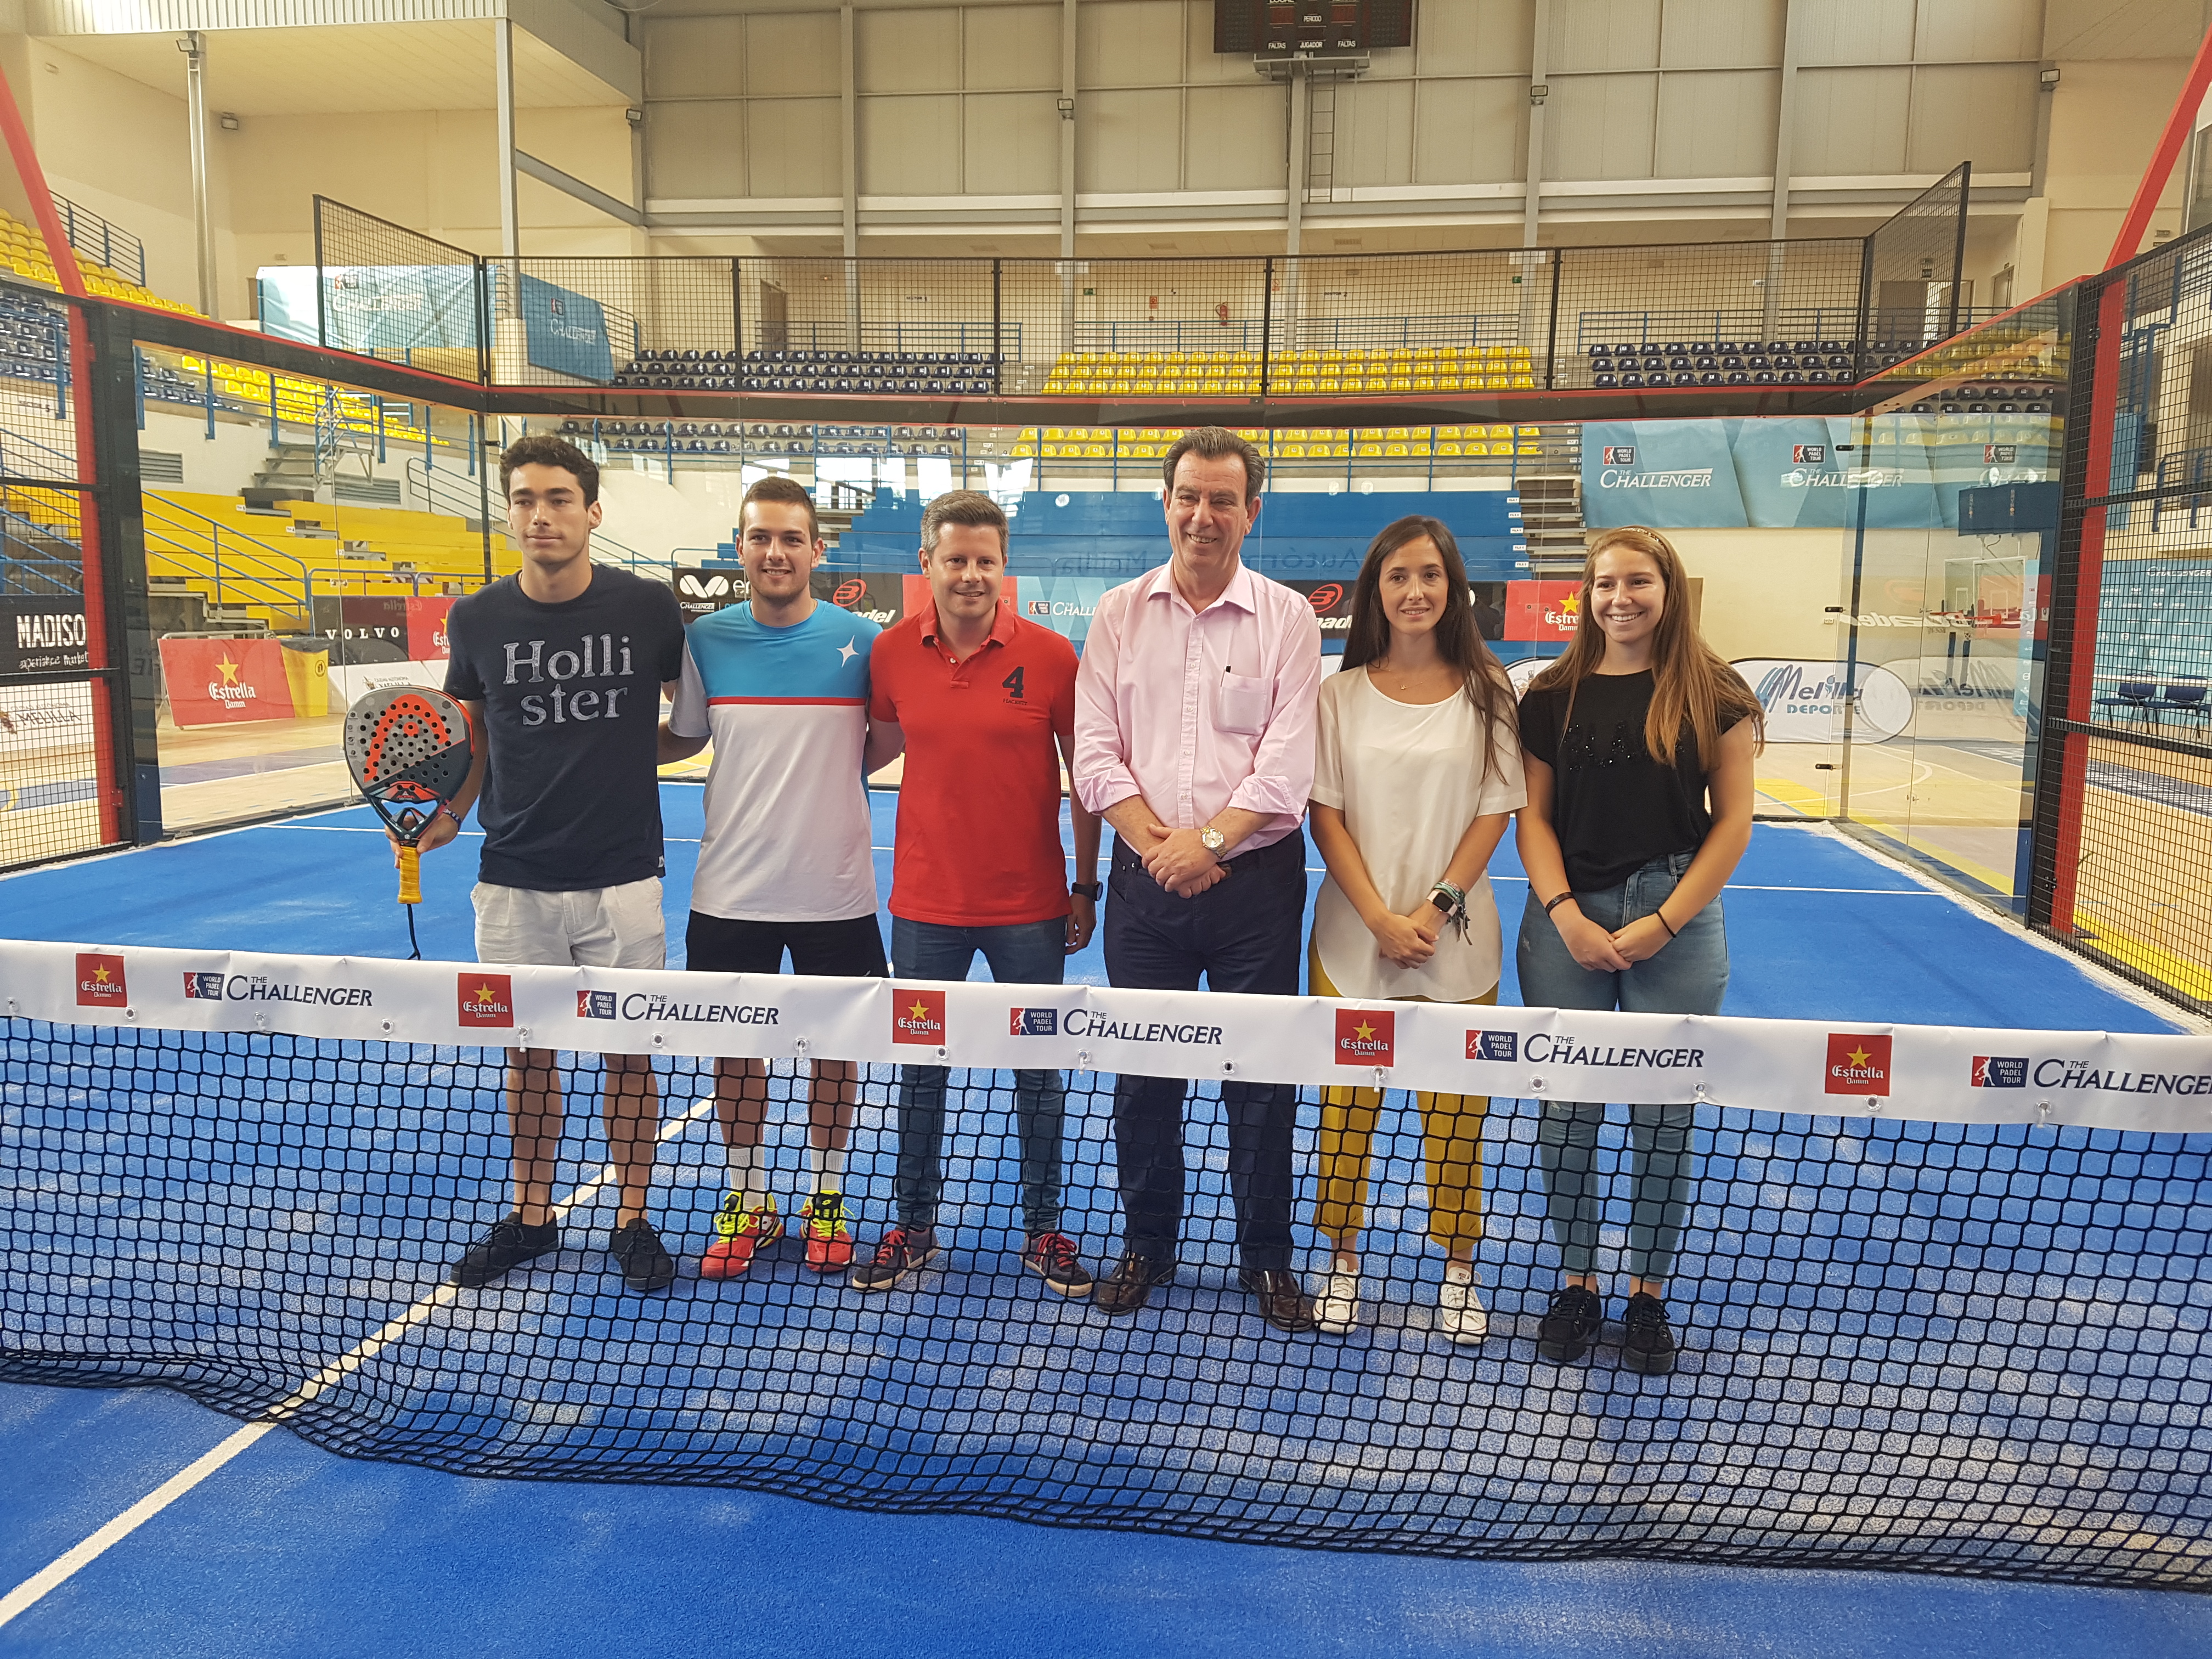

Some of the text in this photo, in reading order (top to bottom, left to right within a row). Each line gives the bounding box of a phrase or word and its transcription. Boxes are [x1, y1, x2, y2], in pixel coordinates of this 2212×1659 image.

[1600, 469, 1712, 488] CHALLENGER
[1545, 611, 1579, 624] Estre
[17, 614, 86, 648] MADISO
[325, 627, 400, 640] VOLVO
[503, 633, 634, 685] Holli
[1002, 666, 1024, 698] 4
[209, 681, 257, 701] Estrella
[224, 699, 246, 709] Damm
[521, 684, 628, 726] ster
[1787, 704, 1861, 715] DEPORE
[81, 980, 122, 993] Estrella
[227, 975, 373, 1007] CHALLENGER
[462, 1001, 508, 1013] Estrella
[622, 993, 779, 1024] CHALLENGER
[898, 1017, 941, 1031] Estrella
[1063, 1009, 1222, 1045] CHALLENGER
[1341, 1037, 1389, 1052] Estrella
[1555, 1035, 1575, 1044] THE
[1525, 1034, 1704, 1068] CHALLENGER
[2069, 1060, 2089, 1069] THE
[1832, 1065, 1884, 1080] Estrella
[2002, 1076, 2022, 1084] TOUR
[2034, 1059, 2212, 1095] CHALLENGE
[1847, 1077, 1869, 1085] Damm
